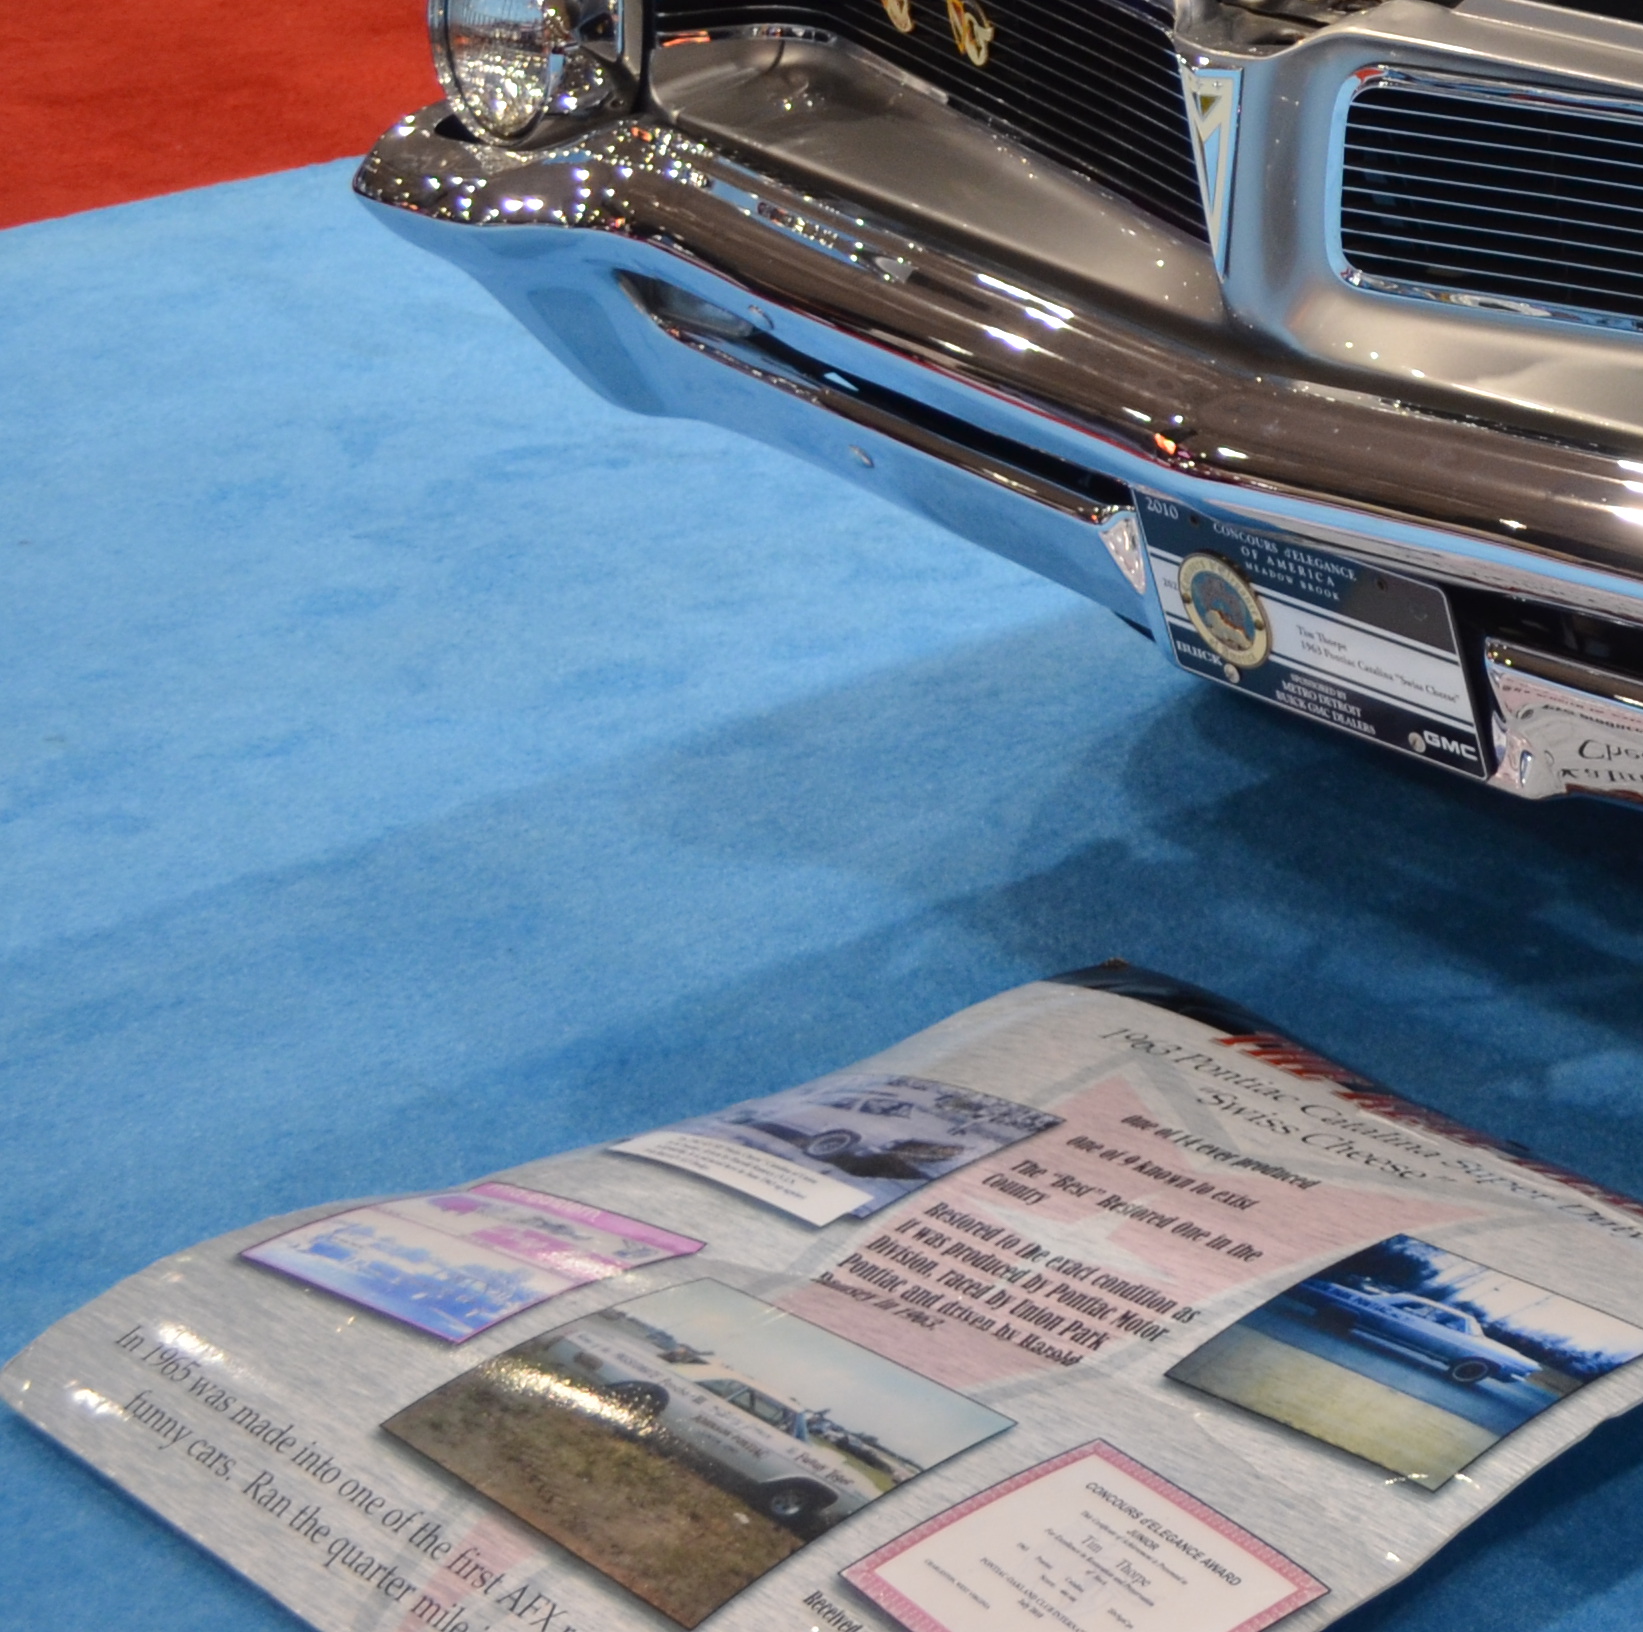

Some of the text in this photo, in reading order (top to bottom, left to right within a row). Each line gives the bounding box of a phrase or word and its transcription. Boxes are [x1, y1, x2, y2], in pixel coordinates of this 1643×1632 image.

[1146, 495, 1180, 520] 2010
[1213, 522, 1279, 554] CONCOURS
[1240, 546, 1336, 588] OF AMERICA
[1245, 562, 1341, 601] MEADOW BROOK
[1175, 639, 1224, 668] BUICK
[1275, 689, 1307, 710] BUICK
[1332, 709, 1377, 736] DEALERS
[1281, 680, 1363, 718] METRO DETROIT
[1422, 729, 1479, 762] GMC
[1100, 1027, 1183, 1058] 1963
[1174, 1051, 1300, 1104] Pontiac
[1300, 1103, 1443, 1160] Catalina
[982, 1173, 1049, 1207] Country
[1066, 1135, 1105, 1154] One
[1099, 1147, 1124, 1162] of
[1132, 1154, 1191, 1190] known
[1192, 1178, 1215, 1196] to
[1210, 1187, 1260, 1211] exist
[1196, 1141, 1241, 1162] ever
[1233, 1156, 1321, 1191] produced
[1011, 1159, 1048, 1179] The
[1097, 1193, 1181, 1231] Restored
[1173, 1220, 1211, 1244] One
[1205, 1233, 1232, 1253] in
[1227, 1241, 1263, 1263] the
[912, 1226, 1171, 1342] was produced by Pontiac Motor
[923, 1201, 1201, 1324] Restored to the exact condition as
[837, 1252, 1083, 1368] Pontiac and driven by Harold
[866, 1234, 1110, 1352] Division, raced by Union Park
[115, 1324, 569, 1631] In 1965 was made into one of the first AFX
[123, 1389, 472, 1632] funny cars. Ran the quarter mile
[1085, 1481, 1144, 1520] CONCOURS
[1200, 1554, 1242, 1587] AWARD
[1081, 1535, 1104, 1554] Tim
[1115, 1558, 1151, 1589] Thorpe
[1126, 1527, 1160, 1551] JUNIOR
[803, 1587, 863, 1632] Received
